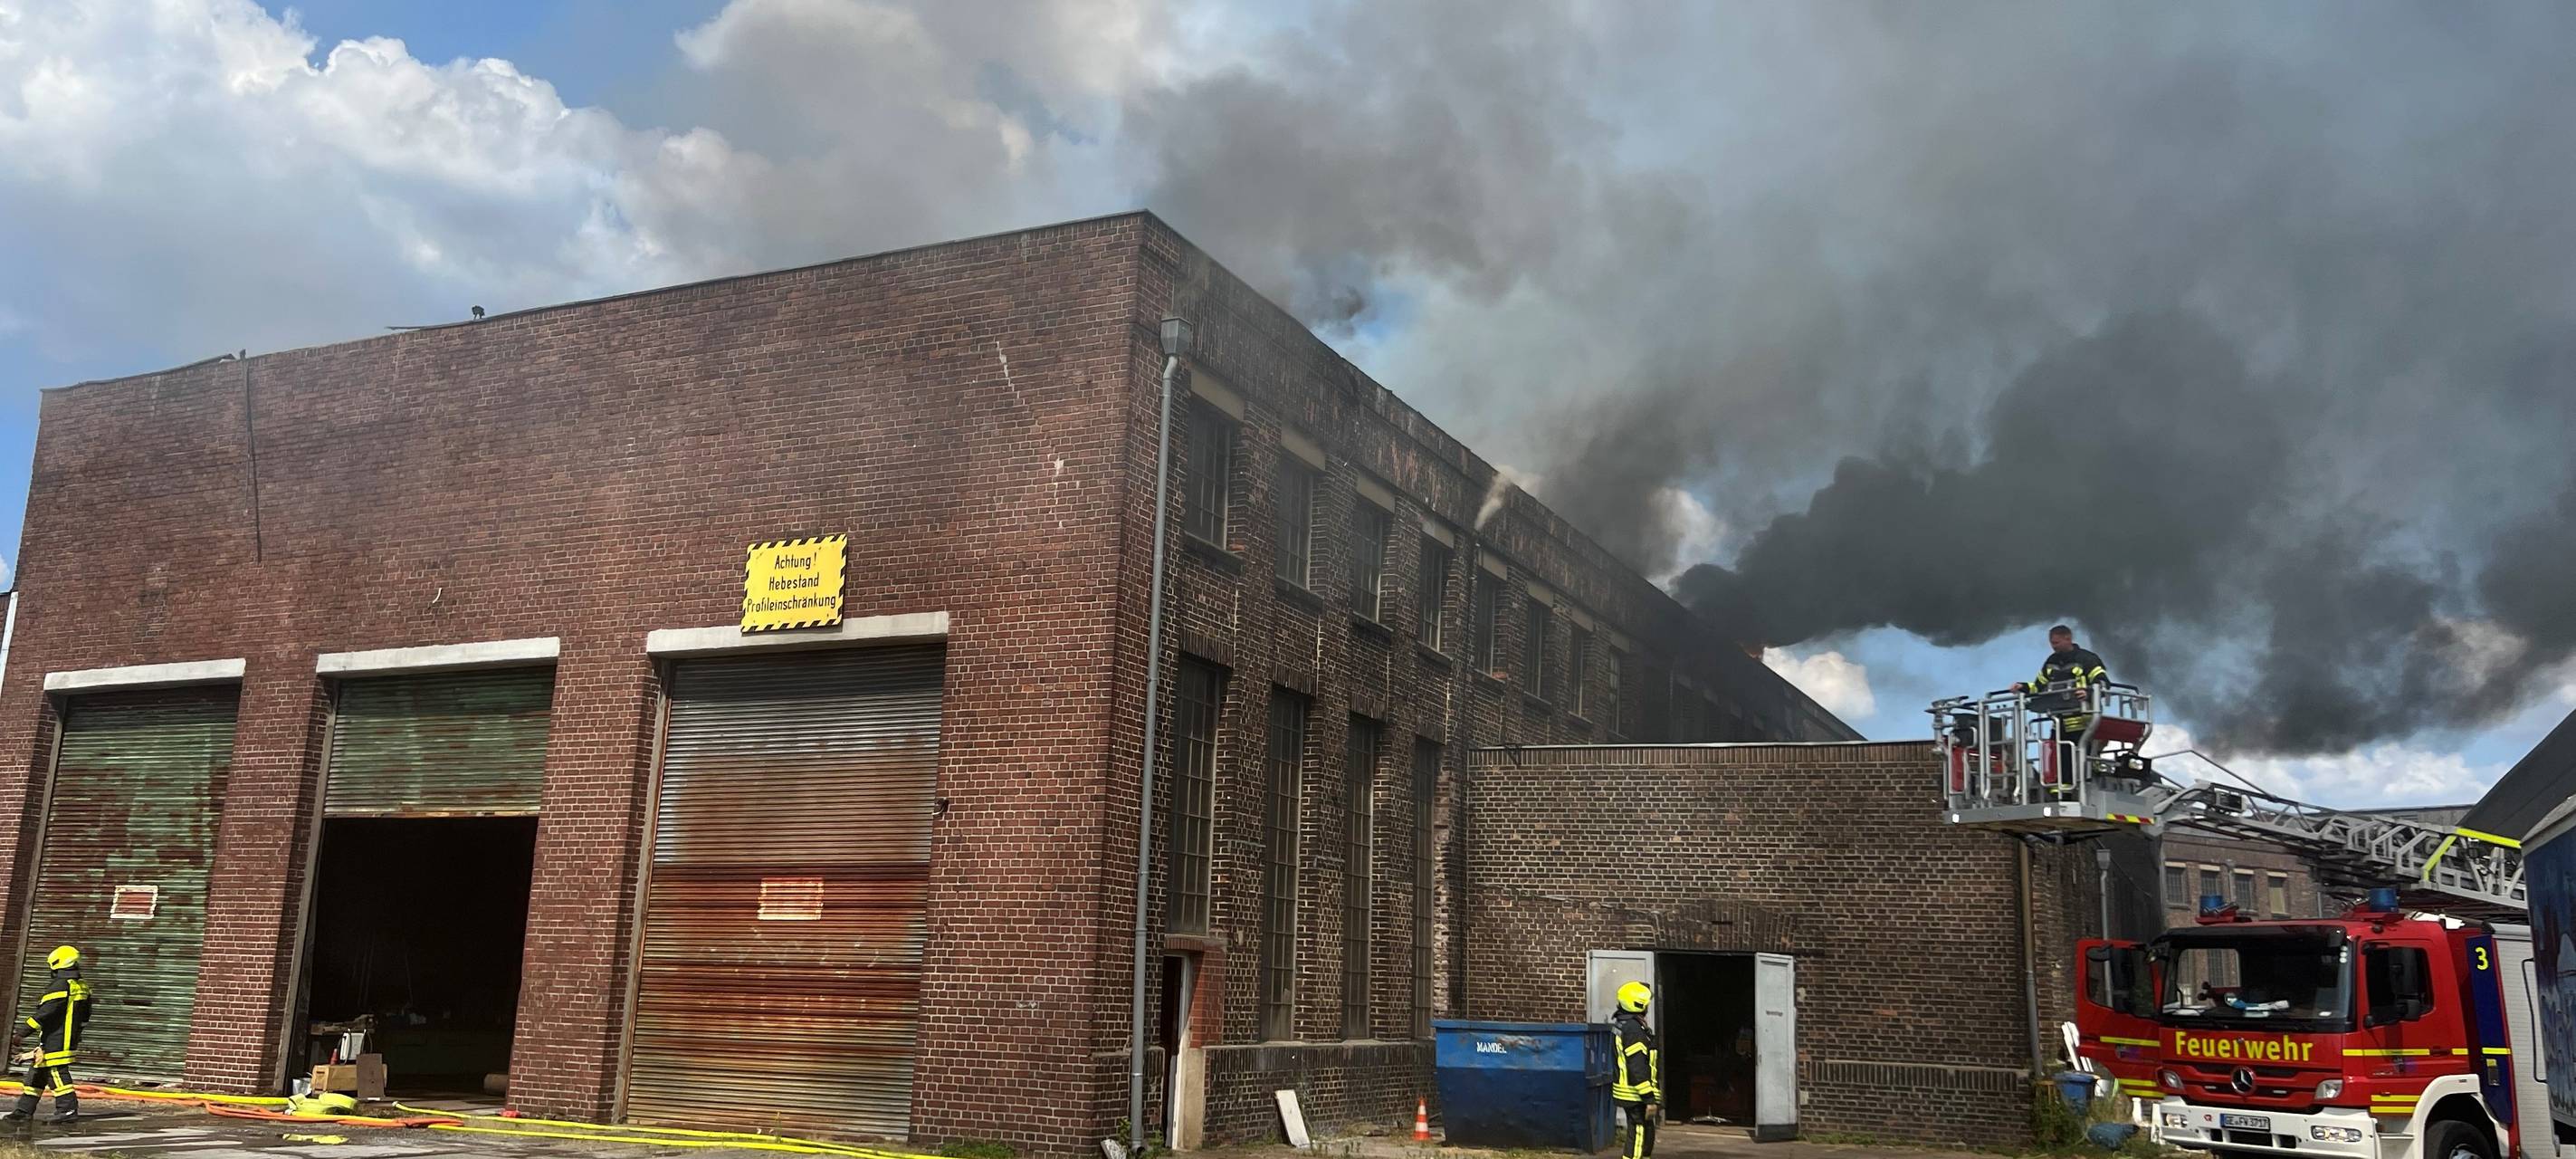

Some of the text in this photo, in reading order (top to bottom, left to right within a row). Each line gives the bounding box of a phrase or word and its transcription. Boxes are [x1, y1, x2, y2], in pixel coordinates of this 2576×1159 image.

[768, 572, 820, 591] Hebestand
[747, 593, 836, 613] Profileinschränkung
[2475, 946, 2489, 971] 3
[2175, 1030, 2314, 1062] Feuerwehr
